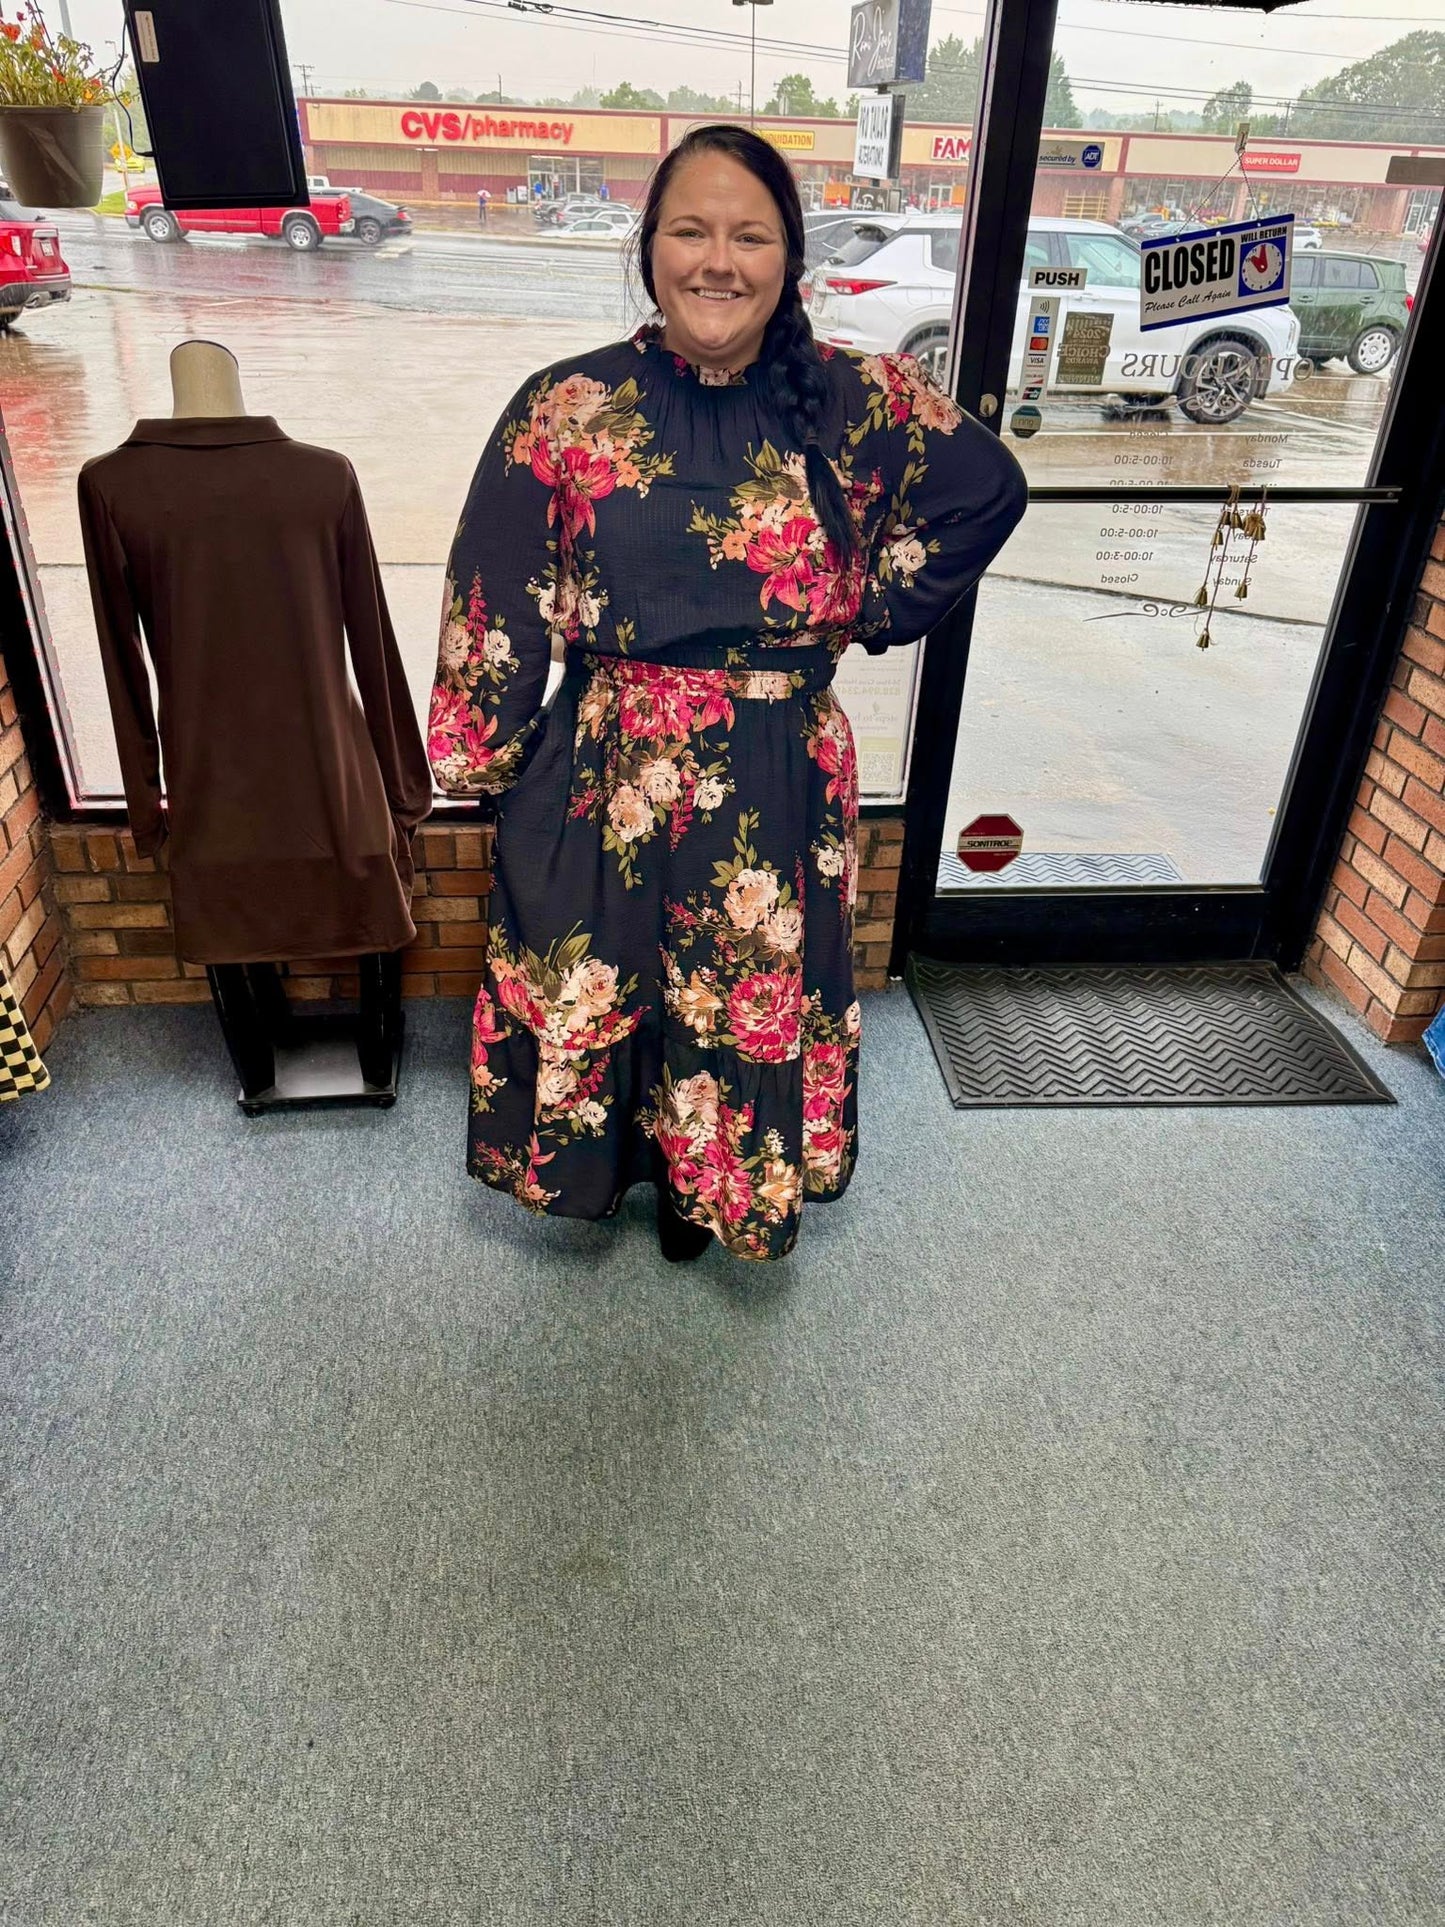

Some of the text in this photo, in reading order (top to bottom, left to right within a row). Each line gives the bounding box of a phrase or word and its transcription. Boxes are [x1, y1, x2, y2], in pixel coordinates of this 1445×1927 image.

[401, 111, 574, 144] CVS/pharmacy
[933, 137, 973, 159] FAM
[1084, 152, 1099, 161] ADT
[1039, 154, 1077, 164] secured by
[1245, 157, 1298, 168] SUPER DOLLAR
[1241, 226, 1287, 243] WILL RETURN
[1144, 238, 1235, 294] CLOSED
[1034, 272, 1080, 286] PUSH
[1144, 289, 1231, 313] Please Call Again
